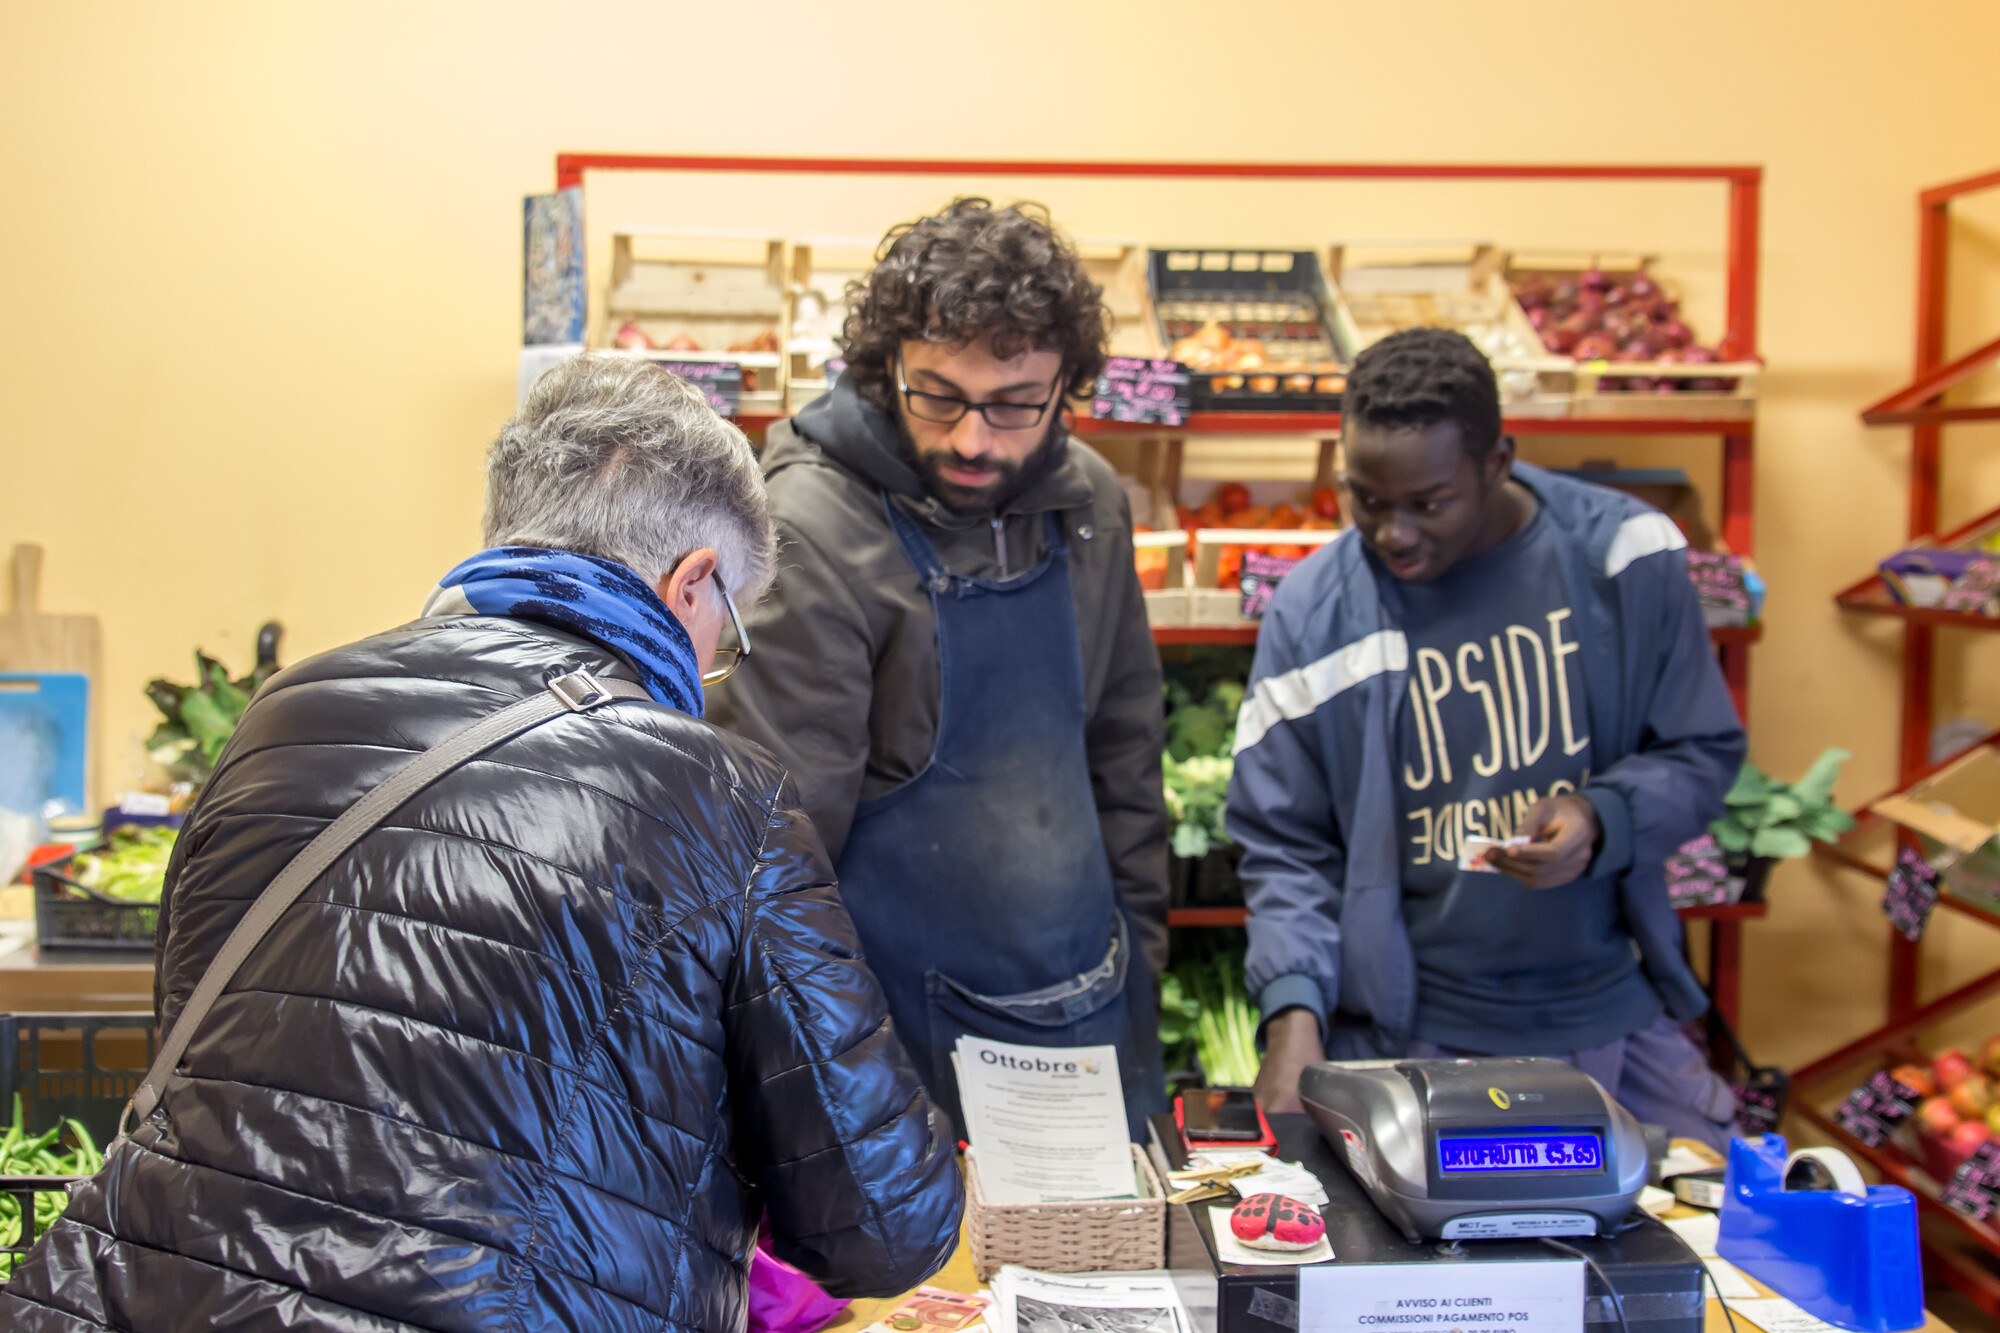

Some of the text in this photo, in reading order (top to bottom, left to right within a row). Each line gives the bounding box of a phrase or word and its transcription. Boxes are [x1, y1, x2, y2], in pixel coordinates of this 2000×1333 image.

[980, 1049, 1078, 1073] Ottobre
[1443, 1144, 1538, 1166] ORTOFRUTTA
[1396, 1297, 1493, 1308] AVVISO AI CLIENTI
[1358, 1311, 1529, 1325] COMMISSIONI PAGAMENTO POS
